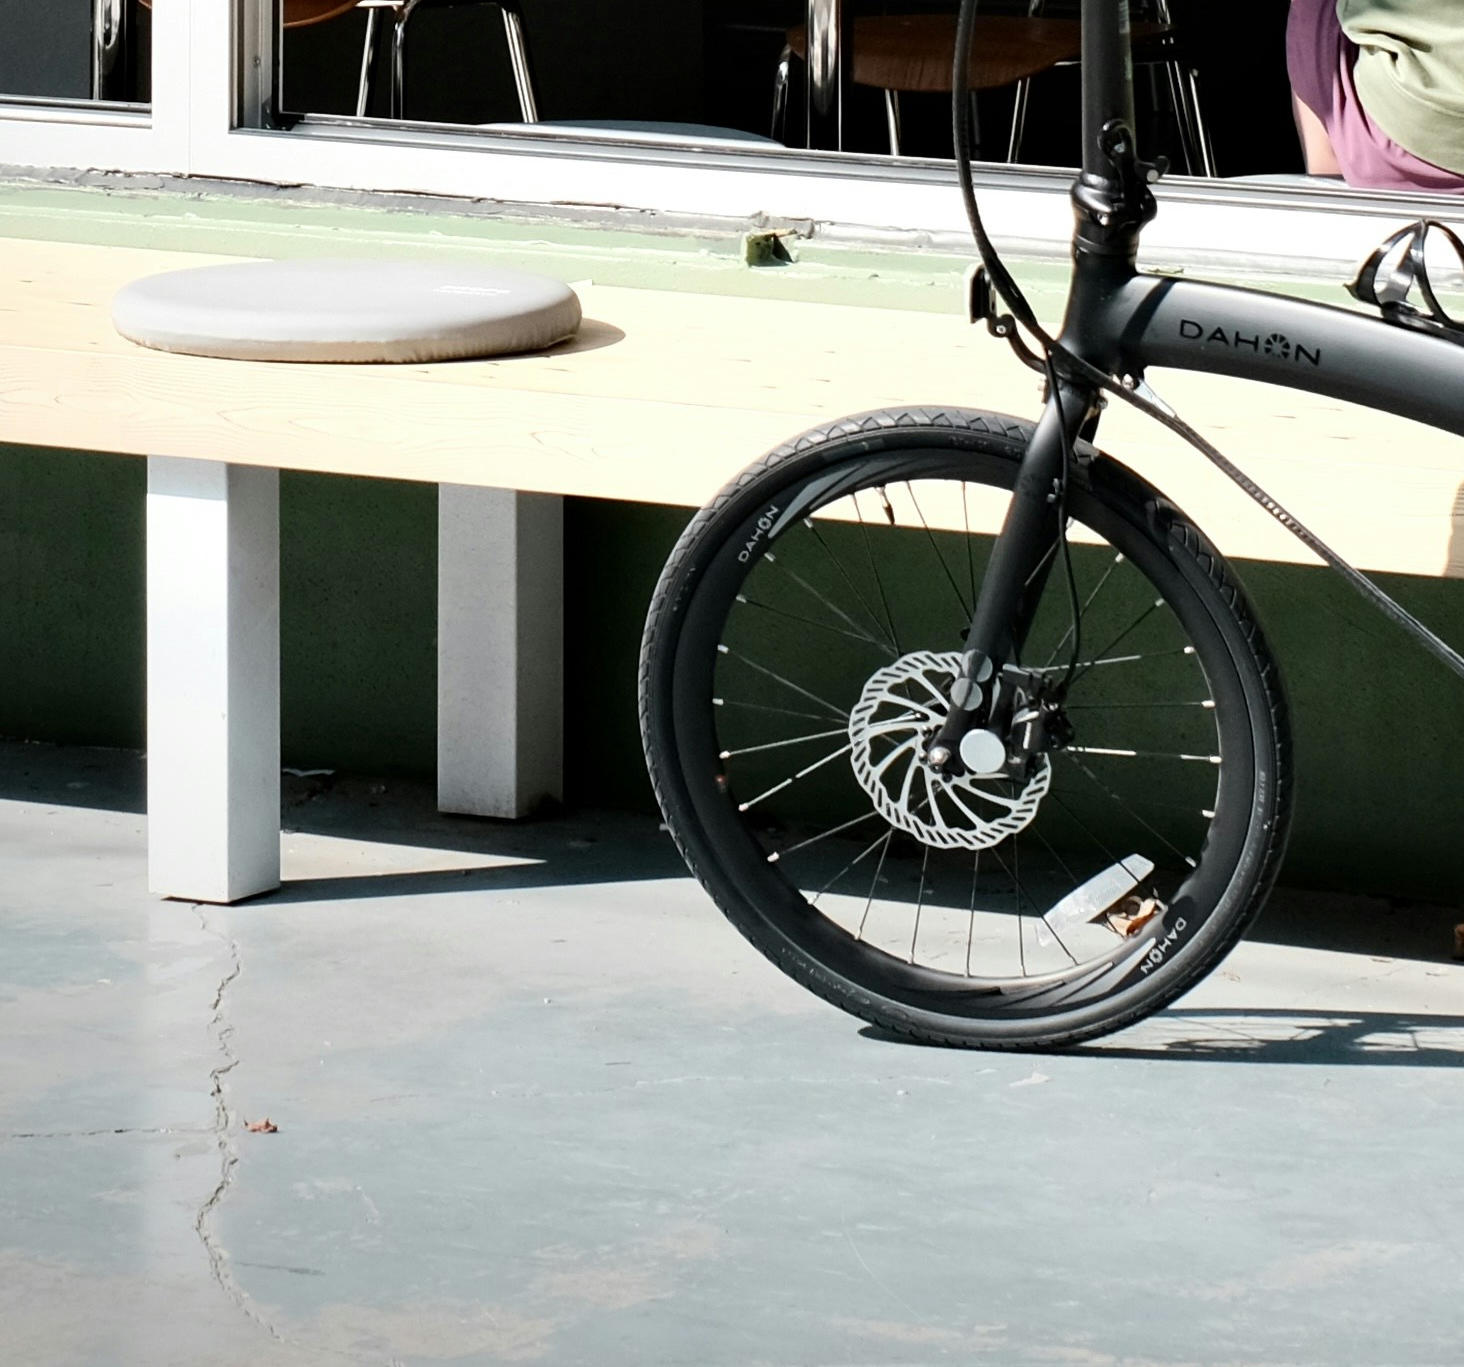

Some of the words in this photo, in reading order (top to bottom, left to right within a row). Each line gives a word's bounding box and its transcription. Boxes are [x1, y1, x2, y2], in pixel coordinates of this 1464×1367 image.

[1179, 318, 1322, 367] DAHON
[737, 503, 780, 564] DAHON
[1140, 916, 1188, 975] DAHON
